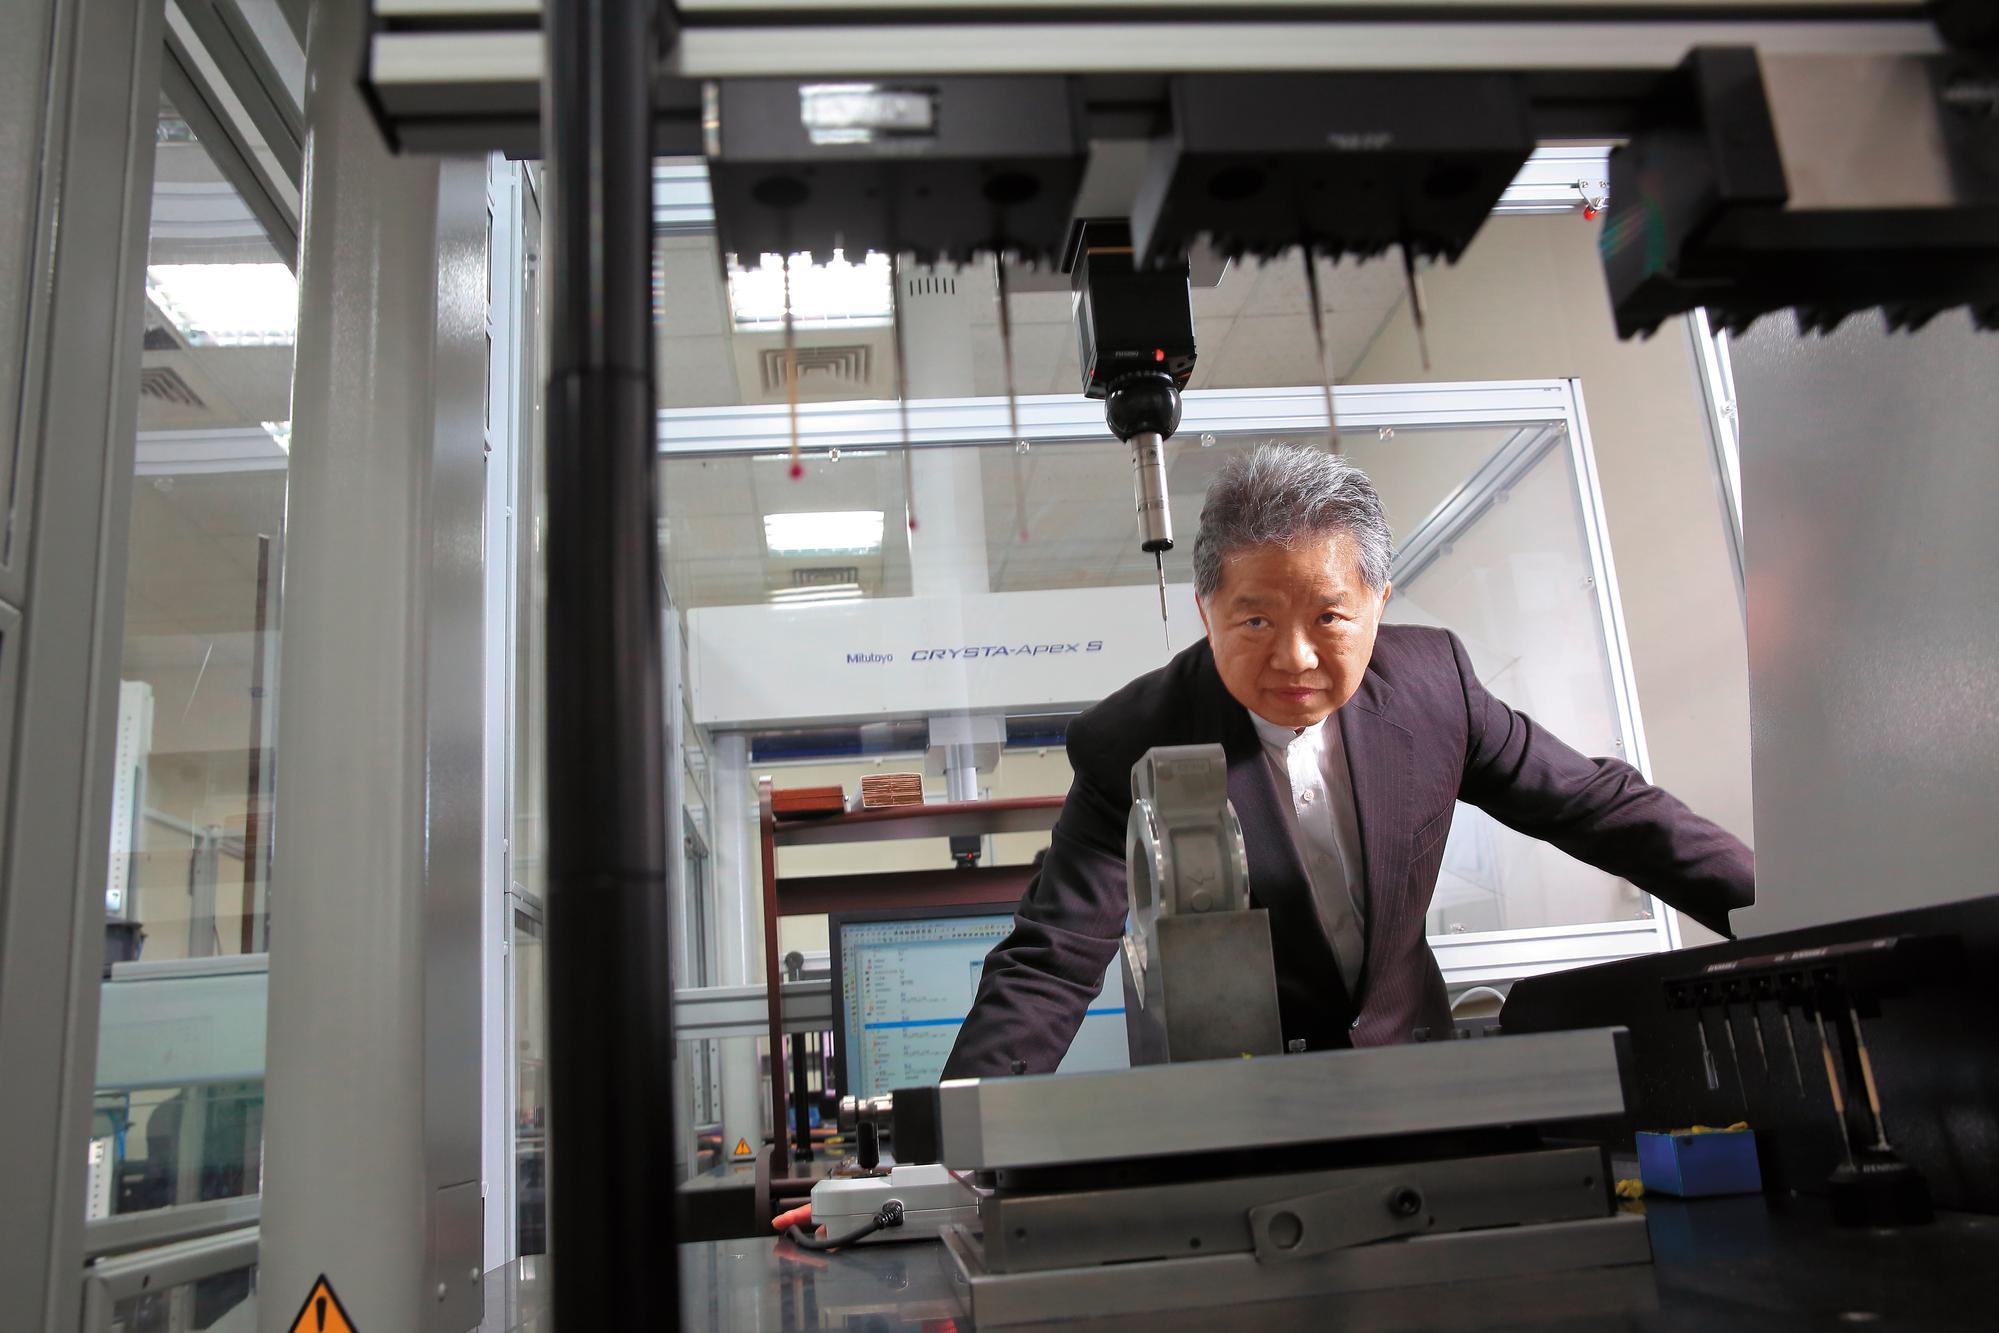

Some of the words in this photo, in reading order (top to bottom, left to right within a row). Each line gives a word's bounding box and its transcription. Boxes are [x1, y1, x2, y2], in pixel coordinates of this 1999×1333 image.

[846, 653, 893, 665] Mitutoyo
[911, 643, 1080, 661] CRYSTA-Apex
[1086, 640, 1103, 652] S
